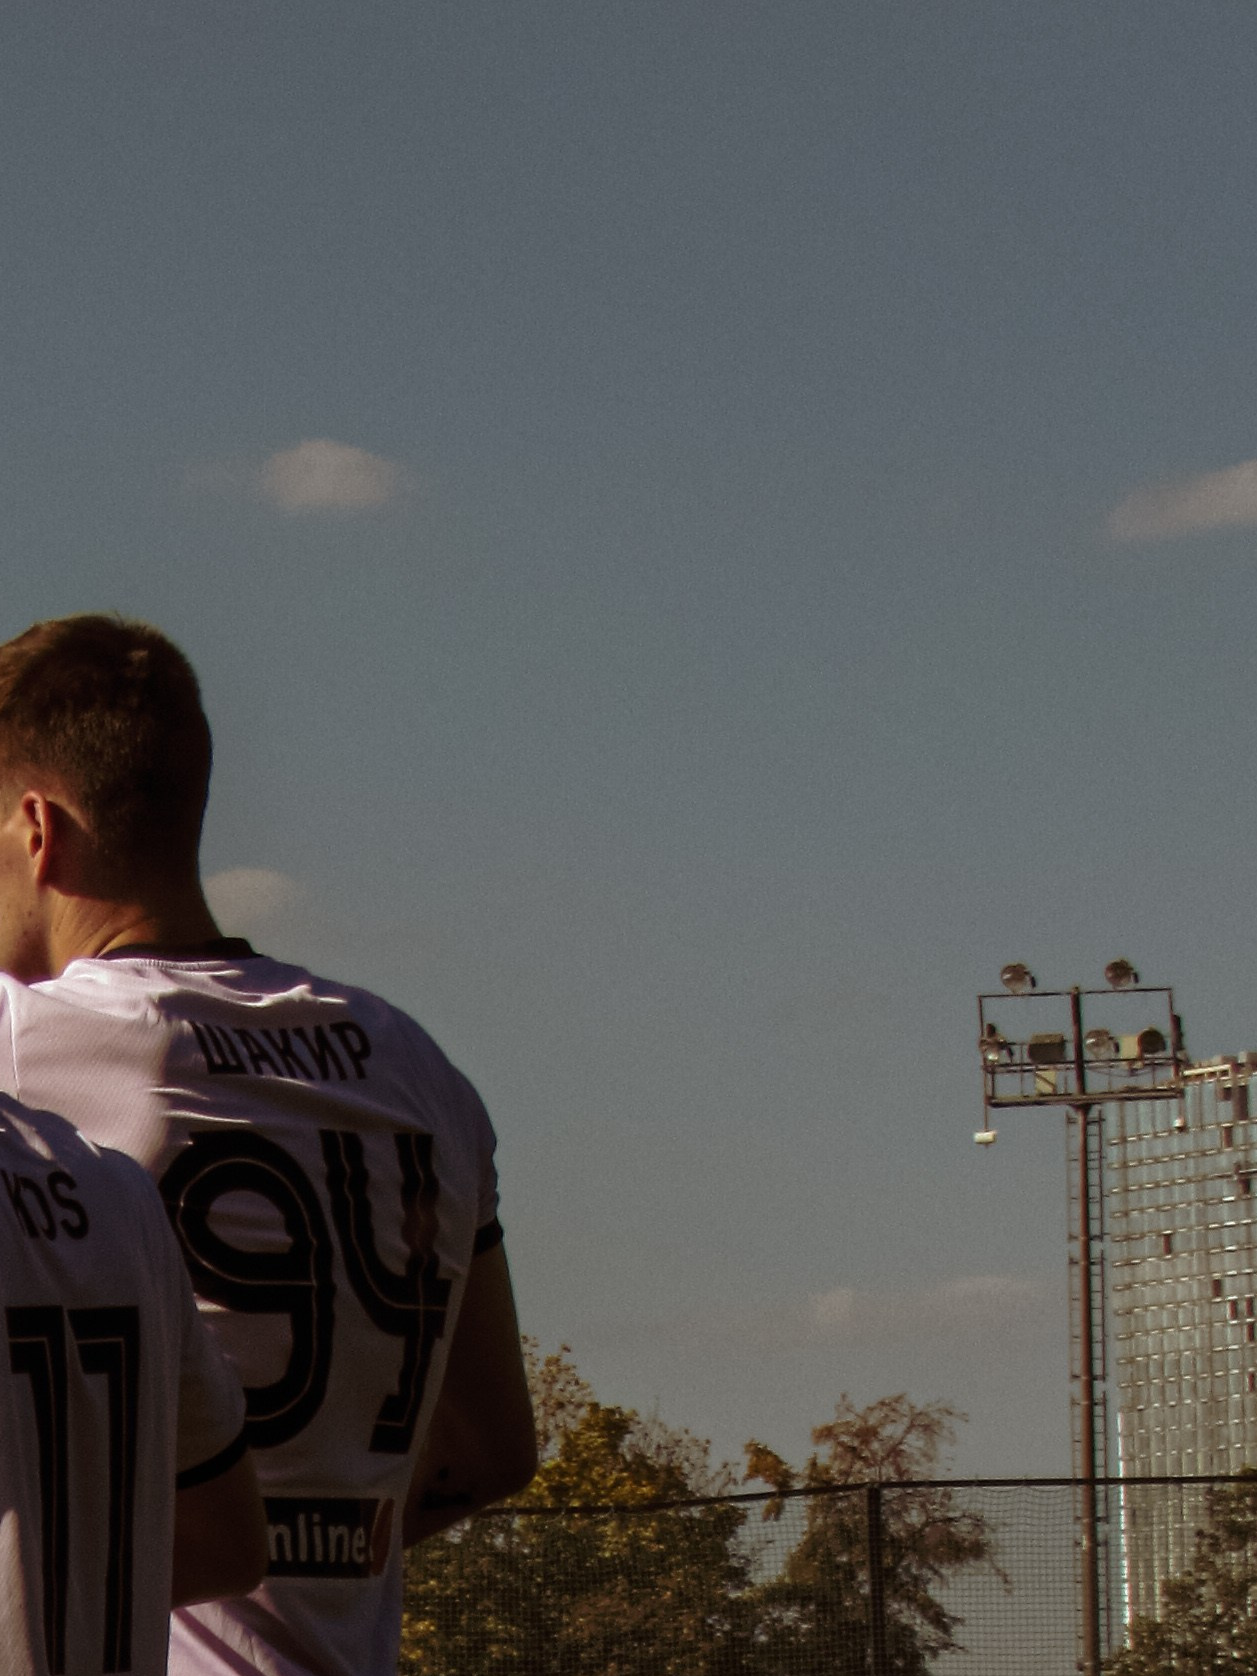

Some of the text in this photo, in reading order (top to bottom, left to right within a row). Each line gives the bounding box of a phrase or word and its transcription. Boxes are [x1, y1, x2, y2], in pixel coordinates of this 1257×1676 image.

[190, 1019, 373, 1081] ШАКИР
[159, 1129, 452, 1454] 94
[5, 1305, 140, 1676] 11
[266, 1511, 367, 1564] nline
